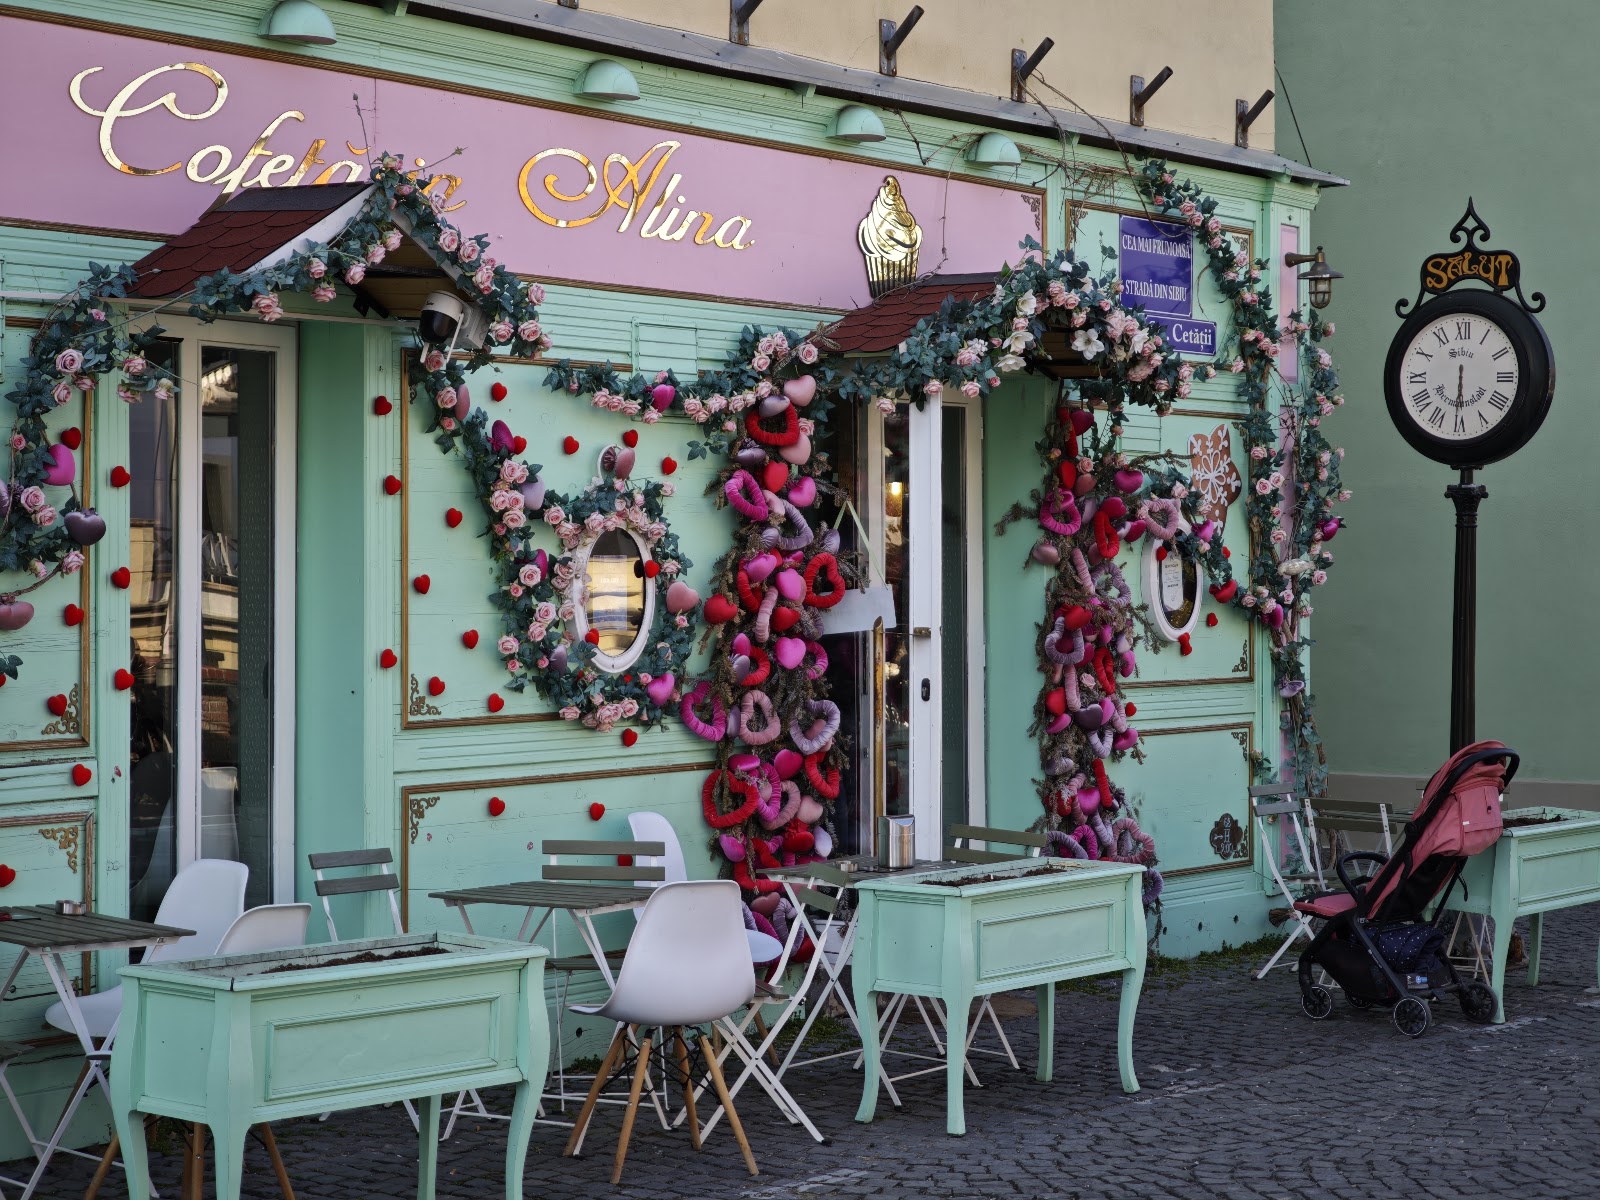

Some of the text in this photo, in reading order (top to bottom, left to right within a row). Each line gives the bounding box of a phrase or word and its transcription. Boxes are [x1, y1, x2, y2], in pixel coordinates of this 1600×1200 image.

[69, 62, 755, 250] Cofetăa Alina
[1122, 234, 1137, 251] CEA
[1137, 236, 1152, 253] MAI
[1154, 283, 1168, 299] DIN
[1168, 285, 1187, 302] SIBIU
[1172, 323, 1212, 351] Cetății
[1433, 327, 1449, 348] XI
[1455, 321, 1471, 340] XII
[1416, 347, 1434, 362] X
[1448, 347, 1474, 360] Sibiu
[1491, 347, 1509, 361] II
[1409, 371, 1426, 384] IX
[1496, 371, 1514, 383] III
[1412, 388, 1434, 413] VIII
[1488, 390, 1509, 411] IIII
[1427, 405, 1447, 428] VII
[1454, 414, 1465, 432] VI
[1478, 409, 1489, 427] V
